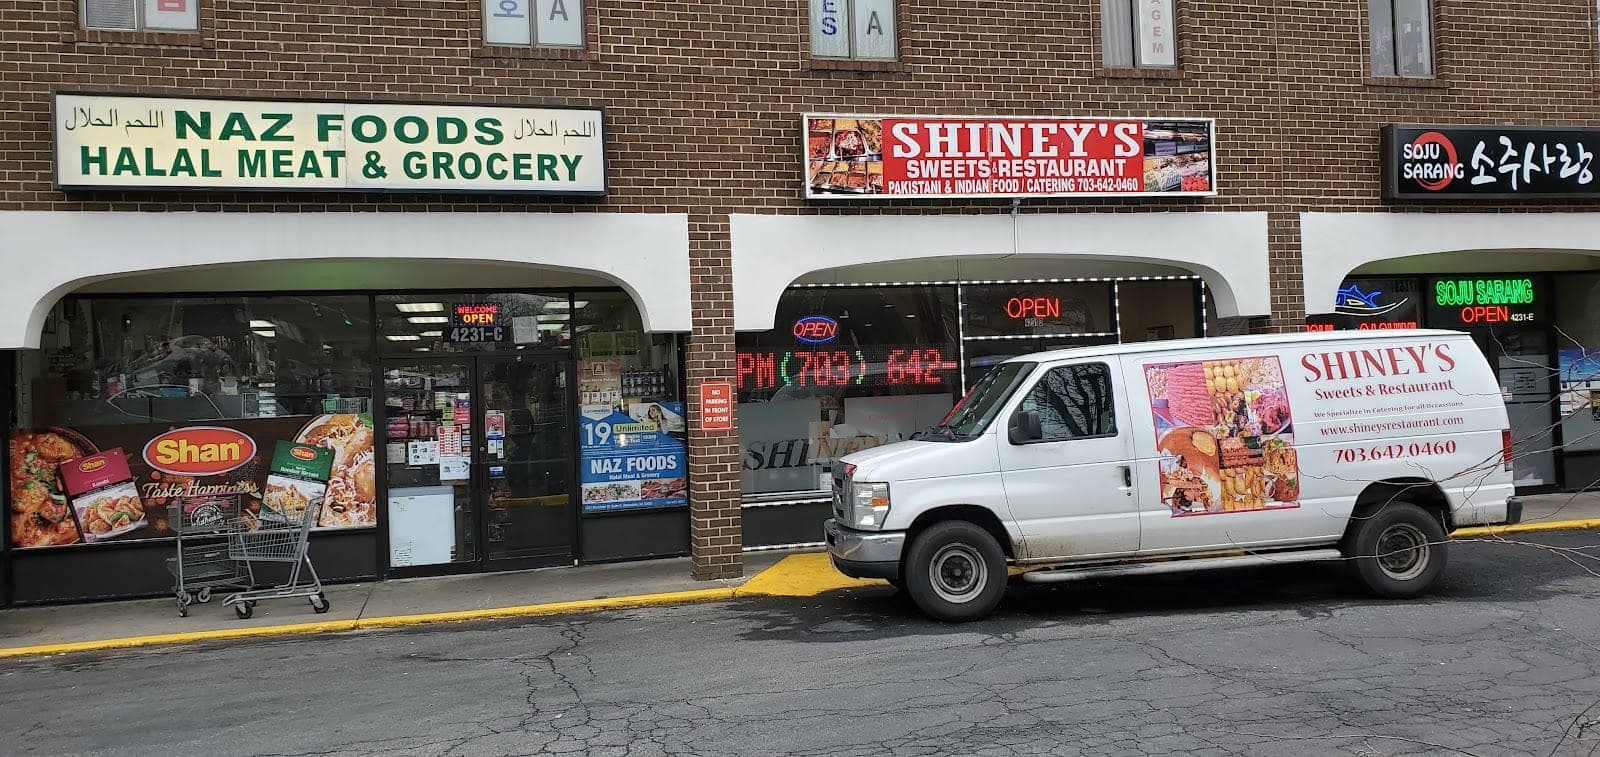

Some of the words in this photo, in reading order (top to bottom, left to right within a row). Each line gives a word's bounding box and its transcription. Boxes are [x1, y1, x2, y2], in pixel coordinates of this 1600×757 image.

[866, 10, 883, 35] A
[65, 106, 117, 130] الحلال
[125, 109, 164, 137] اللحم
[175, 110, 294, 141] NAZ
[316, 114, 504, 145] FOODS
[513, 118, 557, 139] الحلال
[563, 121, 596, 144] اللحم
[892, 122, 1140, 158] SHINEY'S
[1403, 143, 1440, 160] SOJU
[81, 146, 222, 177] HALAL
[238, 150, 346, 178] MEAT
[362, 151, 388, 179] &
[403, 151, 583, 181] GROCERY
[907, 160, 991, 178] SWEETS
[998, 159, 1126, 177] RESTAURANT
[1403, 163, 1465, 179] SARANG
[1470, 135, 1594, 190] 소주사랑
[888, 180, 941, 194] PAKISTANI
[944, 180, 952, 193] &
[955, 179, 989, 193] INDIAN
[993, 179, 1018, 193] FOOD
[1027, 178, 1075, 192] CATERING
[1077, 177, 1138, 191] 703-642-0460
[1436, 280, 1474, 306] SOJU
[1476, 279, 1533, 305] SARANG
[457, 305, 498, 314] WELCOME
[463, 313, 493, 323] OPEN
[1007, 298, 1060, 318] OPEN
[1462, 306, 1508, 323] OPEN
[1510, 313, 1534, 322] 4231-E
[451, 327, 502, 342] 4231-C
[793, 322, 838, 338] OPEN
[736, 351, 775, 389] PM
[781, 350, 866, 387] (703)
[887, 349, 958, 384] 642-
[1301, 342, 1456, 383] SHINEY'S
[1315, 387, 1362, 401] Sweets
[1366, 385, 1376, 397] &
[1379, 379, 1454, 396] Restaurant
[1327, 409, 1363, 418] Specialize
[615, 424, 655, 433] Unlimited
[1320, 416, 1464, 436] www.shineysrestaurant.com
[156, 439, 240, 465] Shan
[292, 448, 315, 459] Shan
[1333, 440, 1456, 464] 703.642.0460
[81, 459, 106, 470] Shan
[591, 458, 622, 474] NAZ
[626, 455, 677, 472] FOODS
[142, 482, 184, 499] Taste
